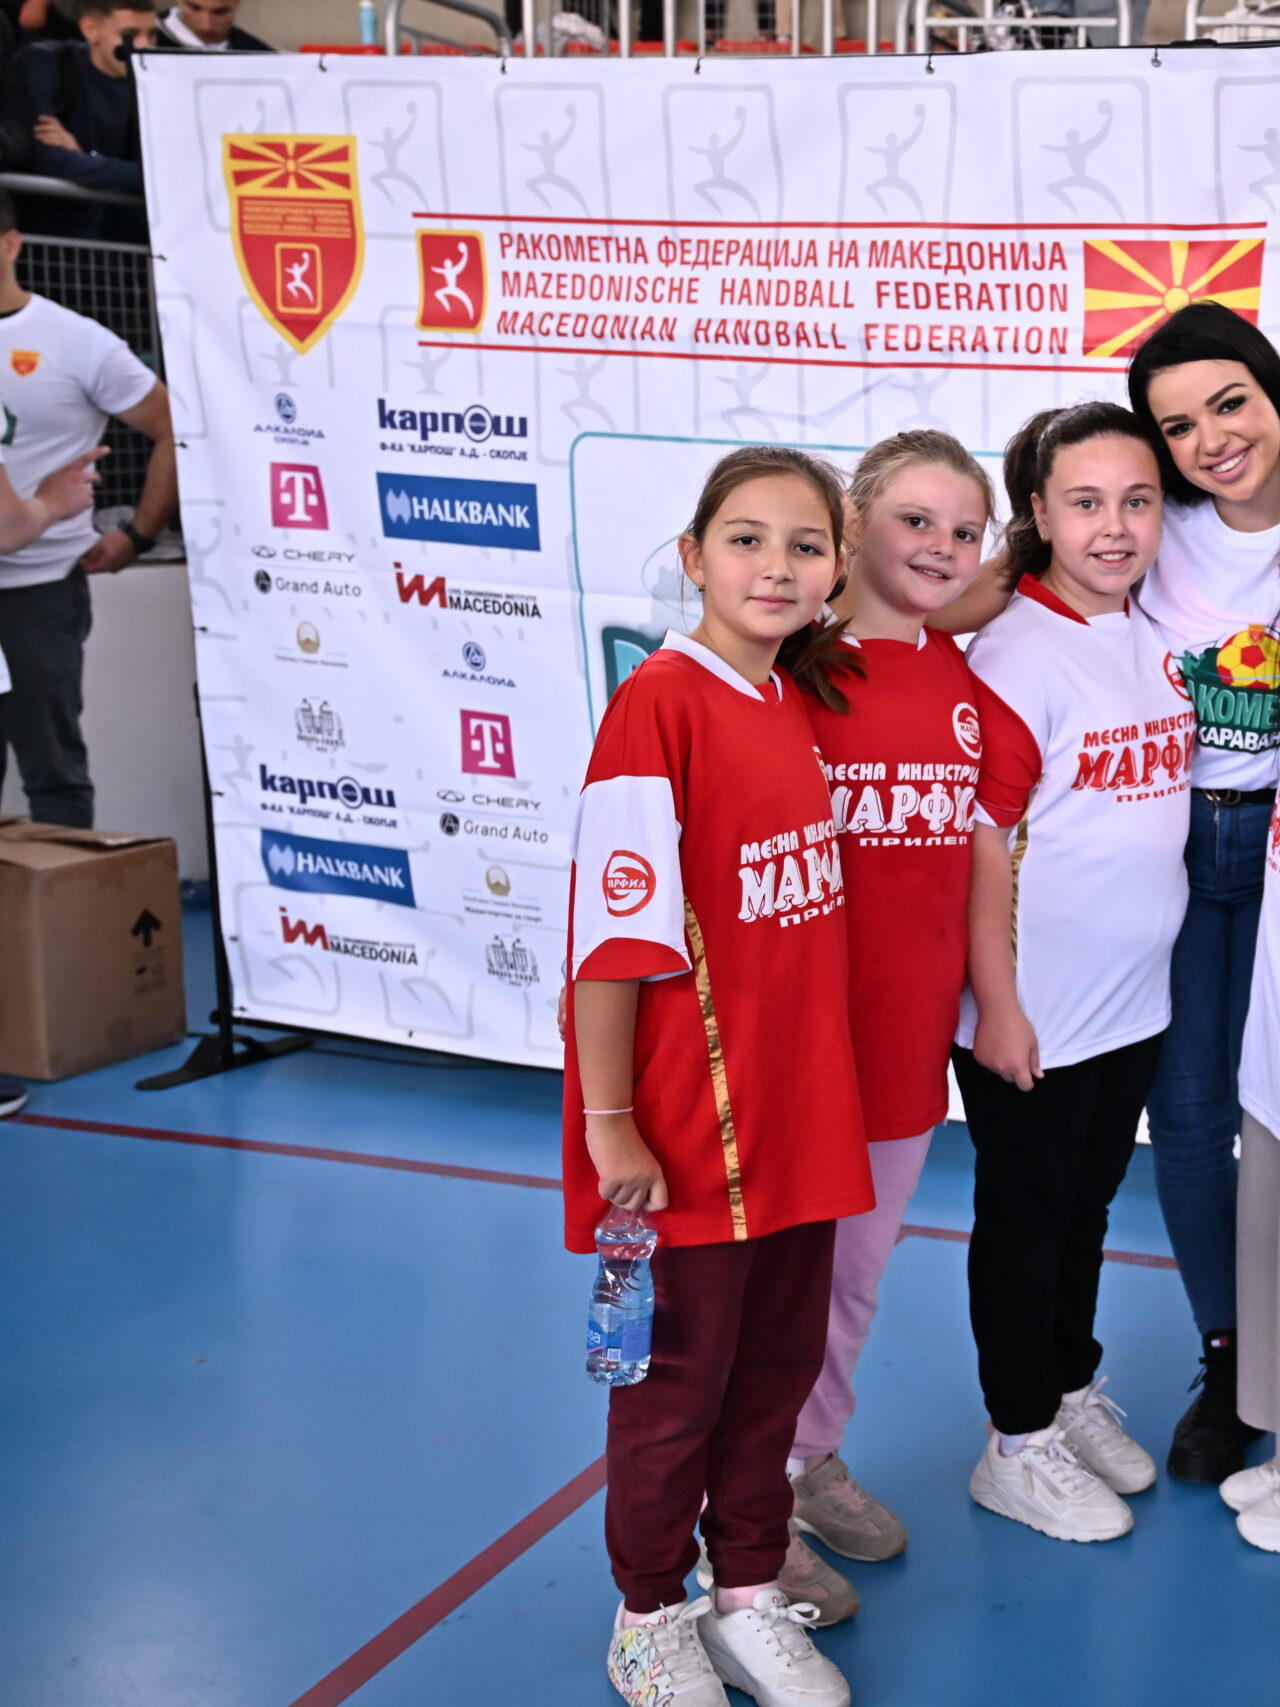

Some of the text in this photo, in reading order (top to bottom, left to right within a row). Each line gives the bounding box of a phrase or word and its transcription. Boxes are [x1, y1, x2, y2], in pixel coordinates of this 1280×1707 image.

[499, 232, 1069, 276] РАКОМЕТНА ФЕДЕРАЦИЈА НА МАКЕДОНИЈА
[501, 271, 1069, 313] MAZEDONISCHE HANDBALL FEDERATION
[497, 310, 1069, 355] MACEDONIAN HANDBALL FEDERATION
[411, 496, 532, 529] HALKBANK
[283, 549, 355, 563] CHERY
[275, 576, 362, 598] Grand Auto
[448, 596, 543, 619] MACEDONIA
[1083, 723, 1139, 749] МЕСНА
[472, 793, 541, 811] CHERY
[464, 819, 549, 845] Grand Auto
[858, 835, 968, 847] ПРИЛЕП
[740, 830, 800, 866] МЕСНА
[297, 851, 406, 890] HALKBANK
[329, 940, 418, 966] MACEDONIA
